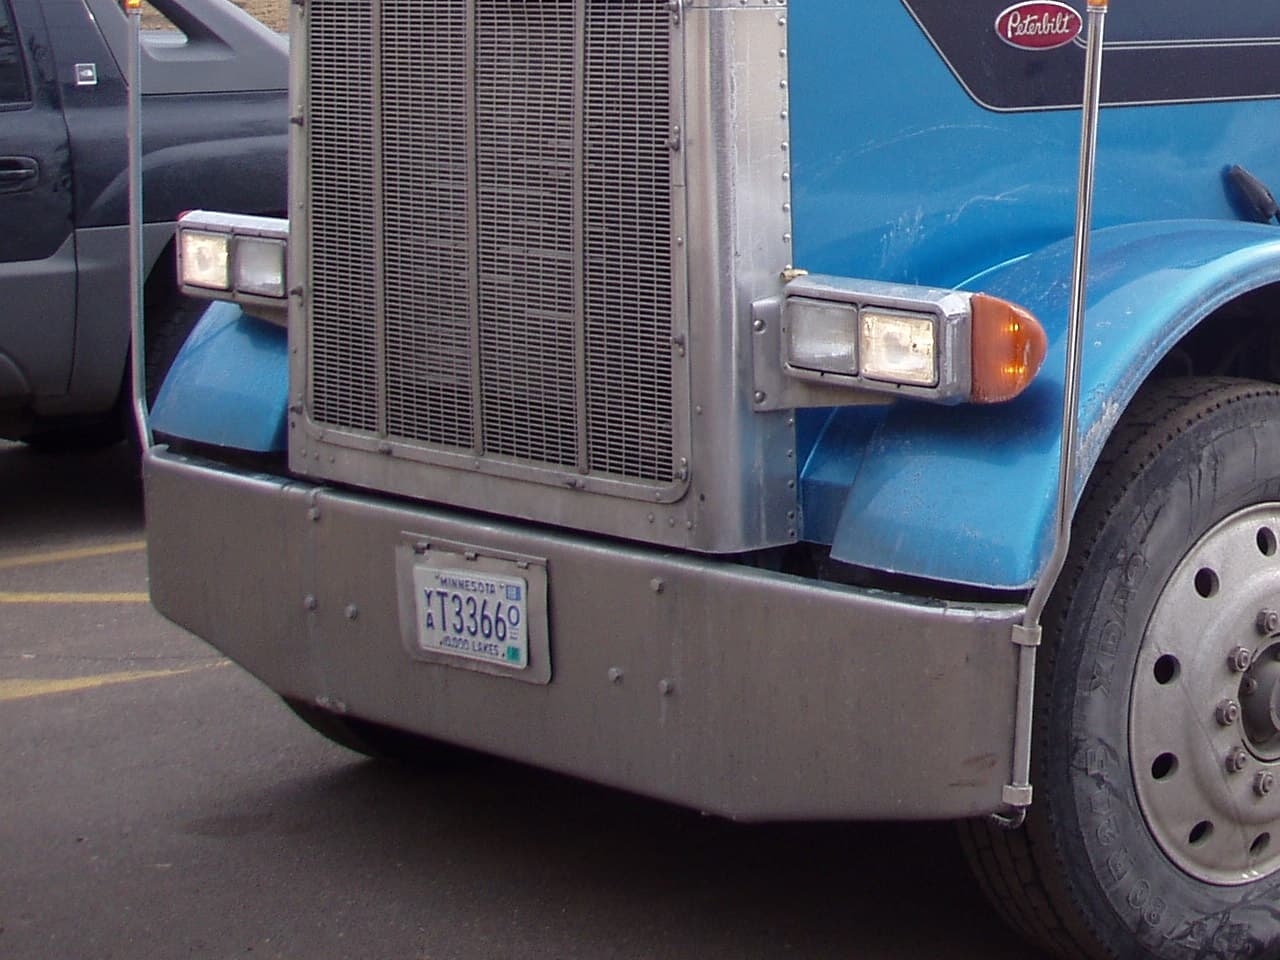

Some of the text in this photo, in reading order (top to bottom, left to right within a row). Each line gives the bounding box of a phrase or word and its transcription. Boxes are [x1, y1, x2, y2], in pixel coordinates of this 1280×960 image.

[1007, 10, 1075, 39] Peterbilt
[439, 576, 496, 595] MINNESOTA
[471, 640, 499, 656] LAKES
